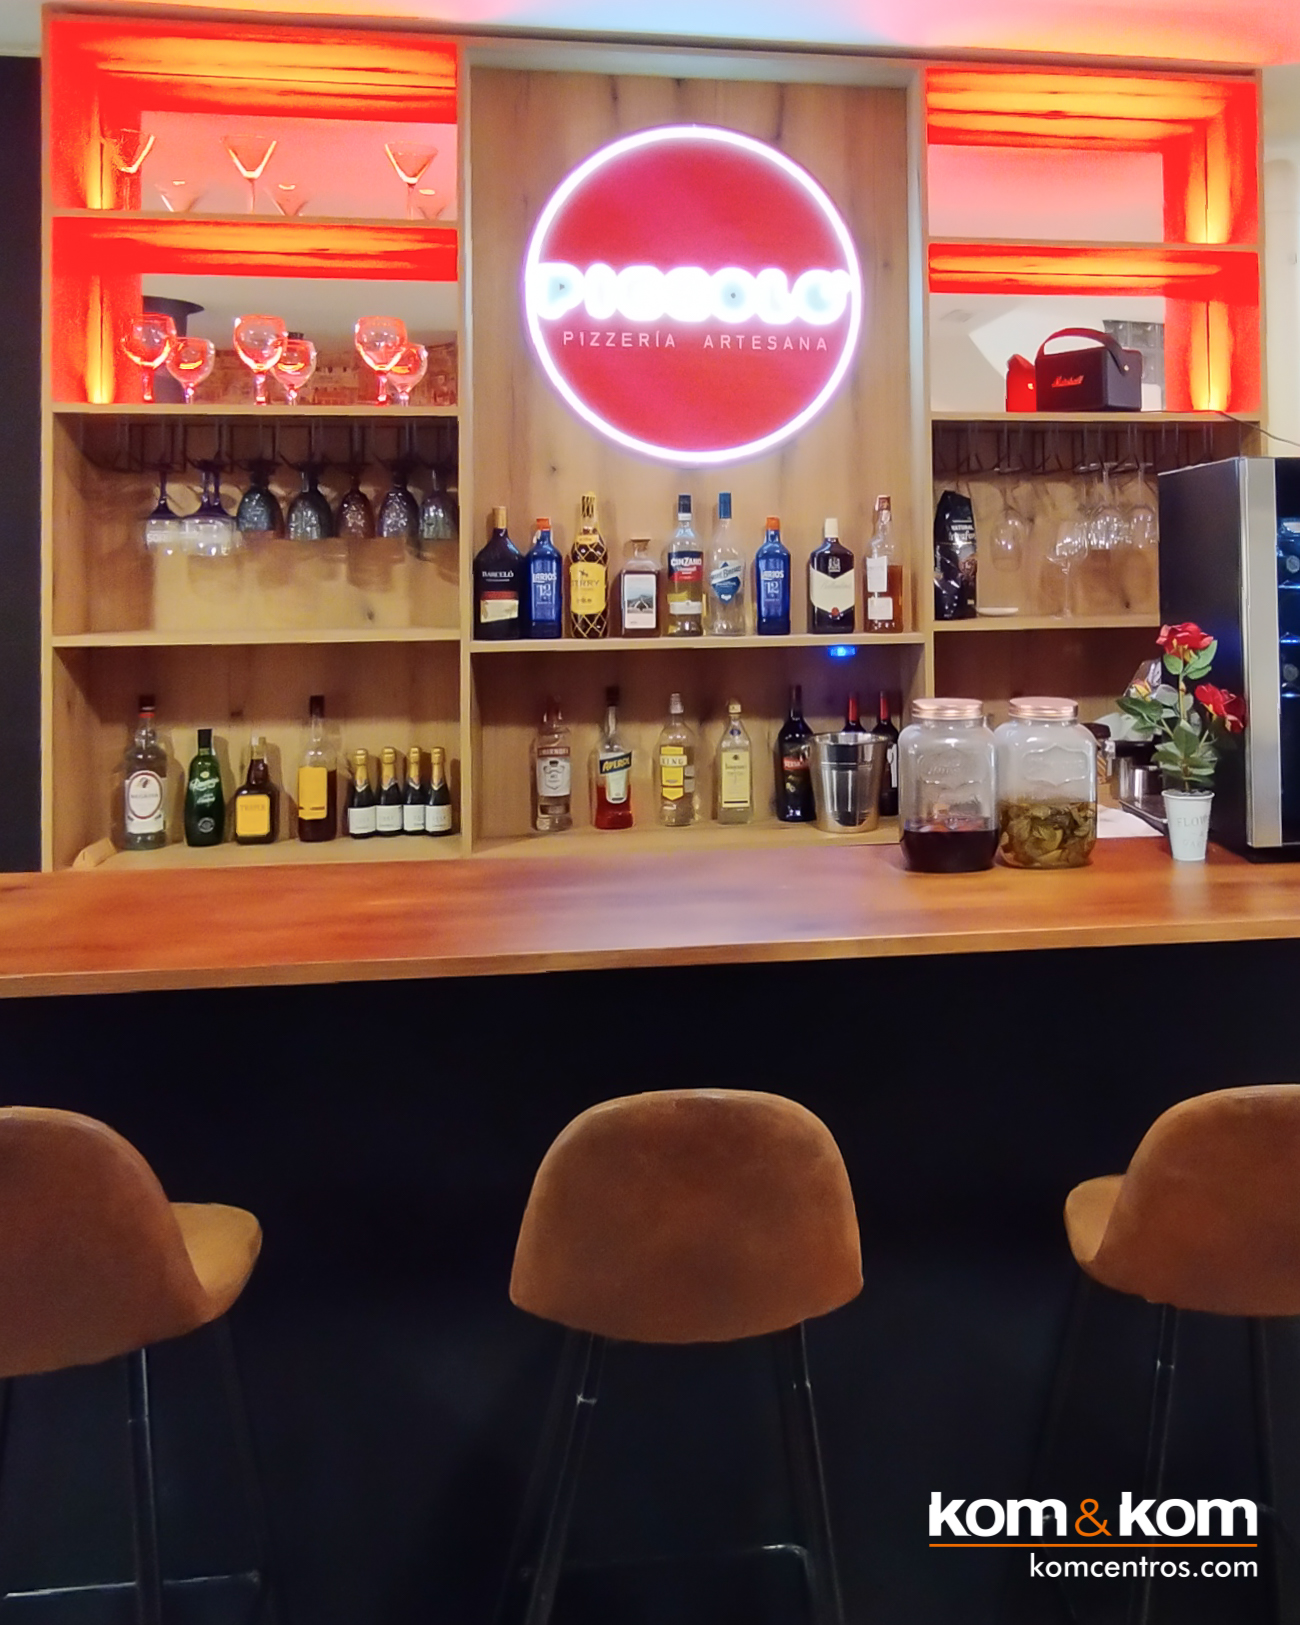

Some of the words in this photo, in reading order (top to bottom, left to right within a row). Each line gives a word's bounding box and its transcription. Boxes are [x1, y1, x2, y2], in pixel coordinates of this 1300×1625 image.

[563, 330, 676, 348] PIZZERÍA
[703, 335, 828, 351] ARTESANA
[671, 557, 702, 567] CINZANO
[533, 572, 557, 584] LARIOS
[761, 570, 784, 581] LARIOS
[765, 581, 779, 594] 12
